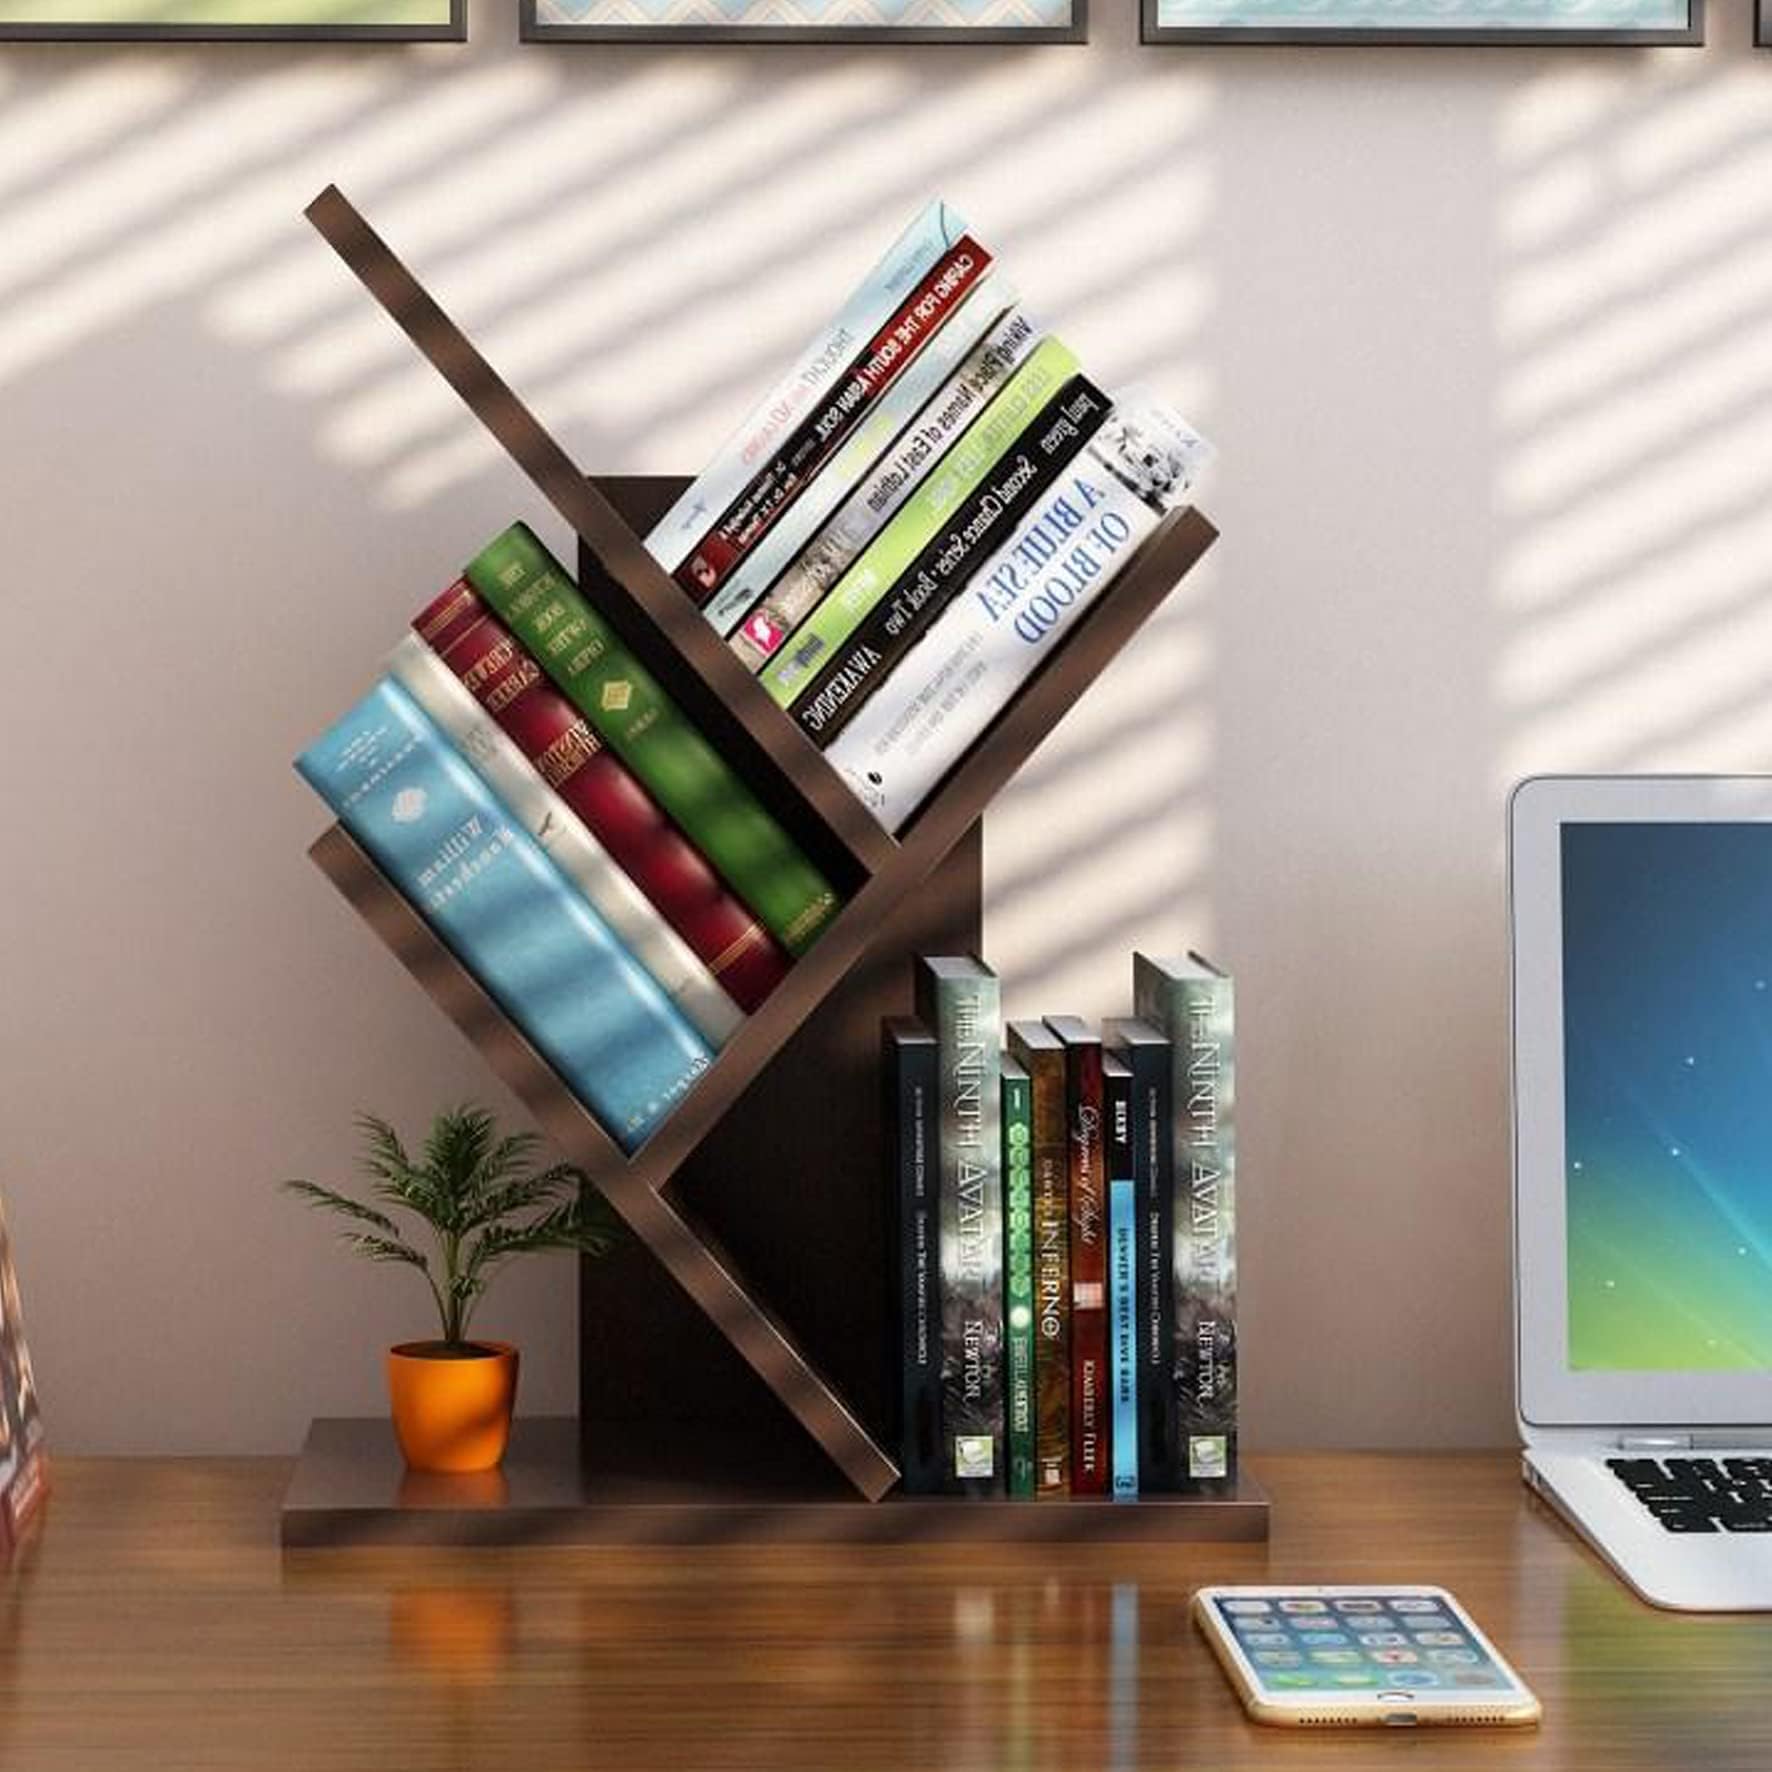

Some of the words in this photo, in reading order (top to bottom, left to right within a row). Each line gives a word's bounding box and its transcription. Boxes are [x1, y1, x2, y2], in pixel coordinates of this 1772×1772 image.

[951, 1042, 985, 1147] NINTH
[1114, 1099, 1127, 1143] BIXBY
[1187, 1043, 1222, 1147] NINTH
[955, 1160, 986, 1282] AVATAR
[1190, 1161, 1222, 1283] AVATAR
[1041, 1222, 1061, 1339] INFERNO
[1117, 1297, 1130, 1329] BEST
[962, 1320, 983, 1402] NEWTON
[1082, 1359, 1096, 1428] KIMBERLY
[1196, 1320, 1216, 1402] NEWTON
